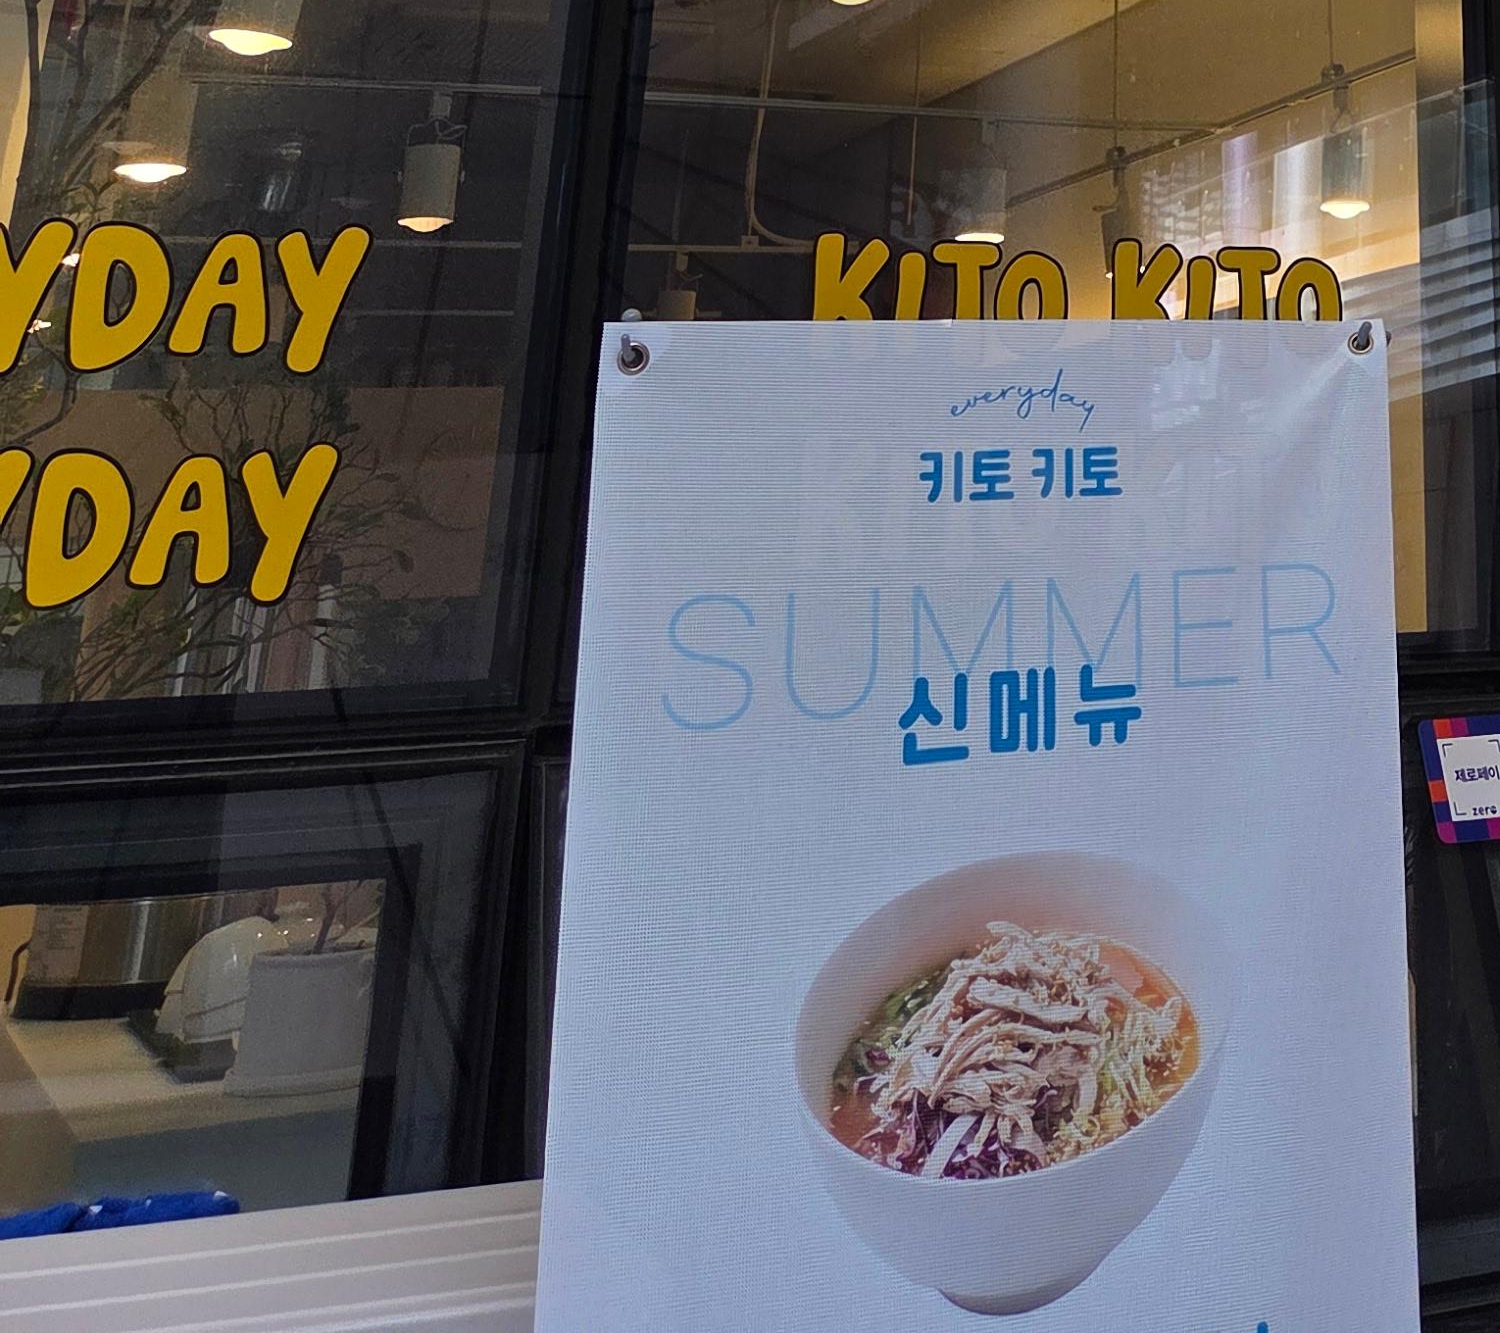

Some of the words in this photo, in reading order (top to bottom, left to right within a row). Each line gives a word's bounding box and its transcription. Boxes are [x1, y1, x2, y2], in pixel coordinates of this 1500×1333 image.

[812, 230, 1069, 321] KITO
[1111, 237, 1343, 321] KITO
[950, 368, 1095, 432] everyday
[918, 449, 1015, 503] 키토
[1031, 445, 1123, 498] 키토
[661, 562, 1343, 736] SUMMER
[898, 664, 1142, 766] 신메뉴
[1454, 765, 1500, 782] 제로페이
[1472, 804, 1498, 816] zero
